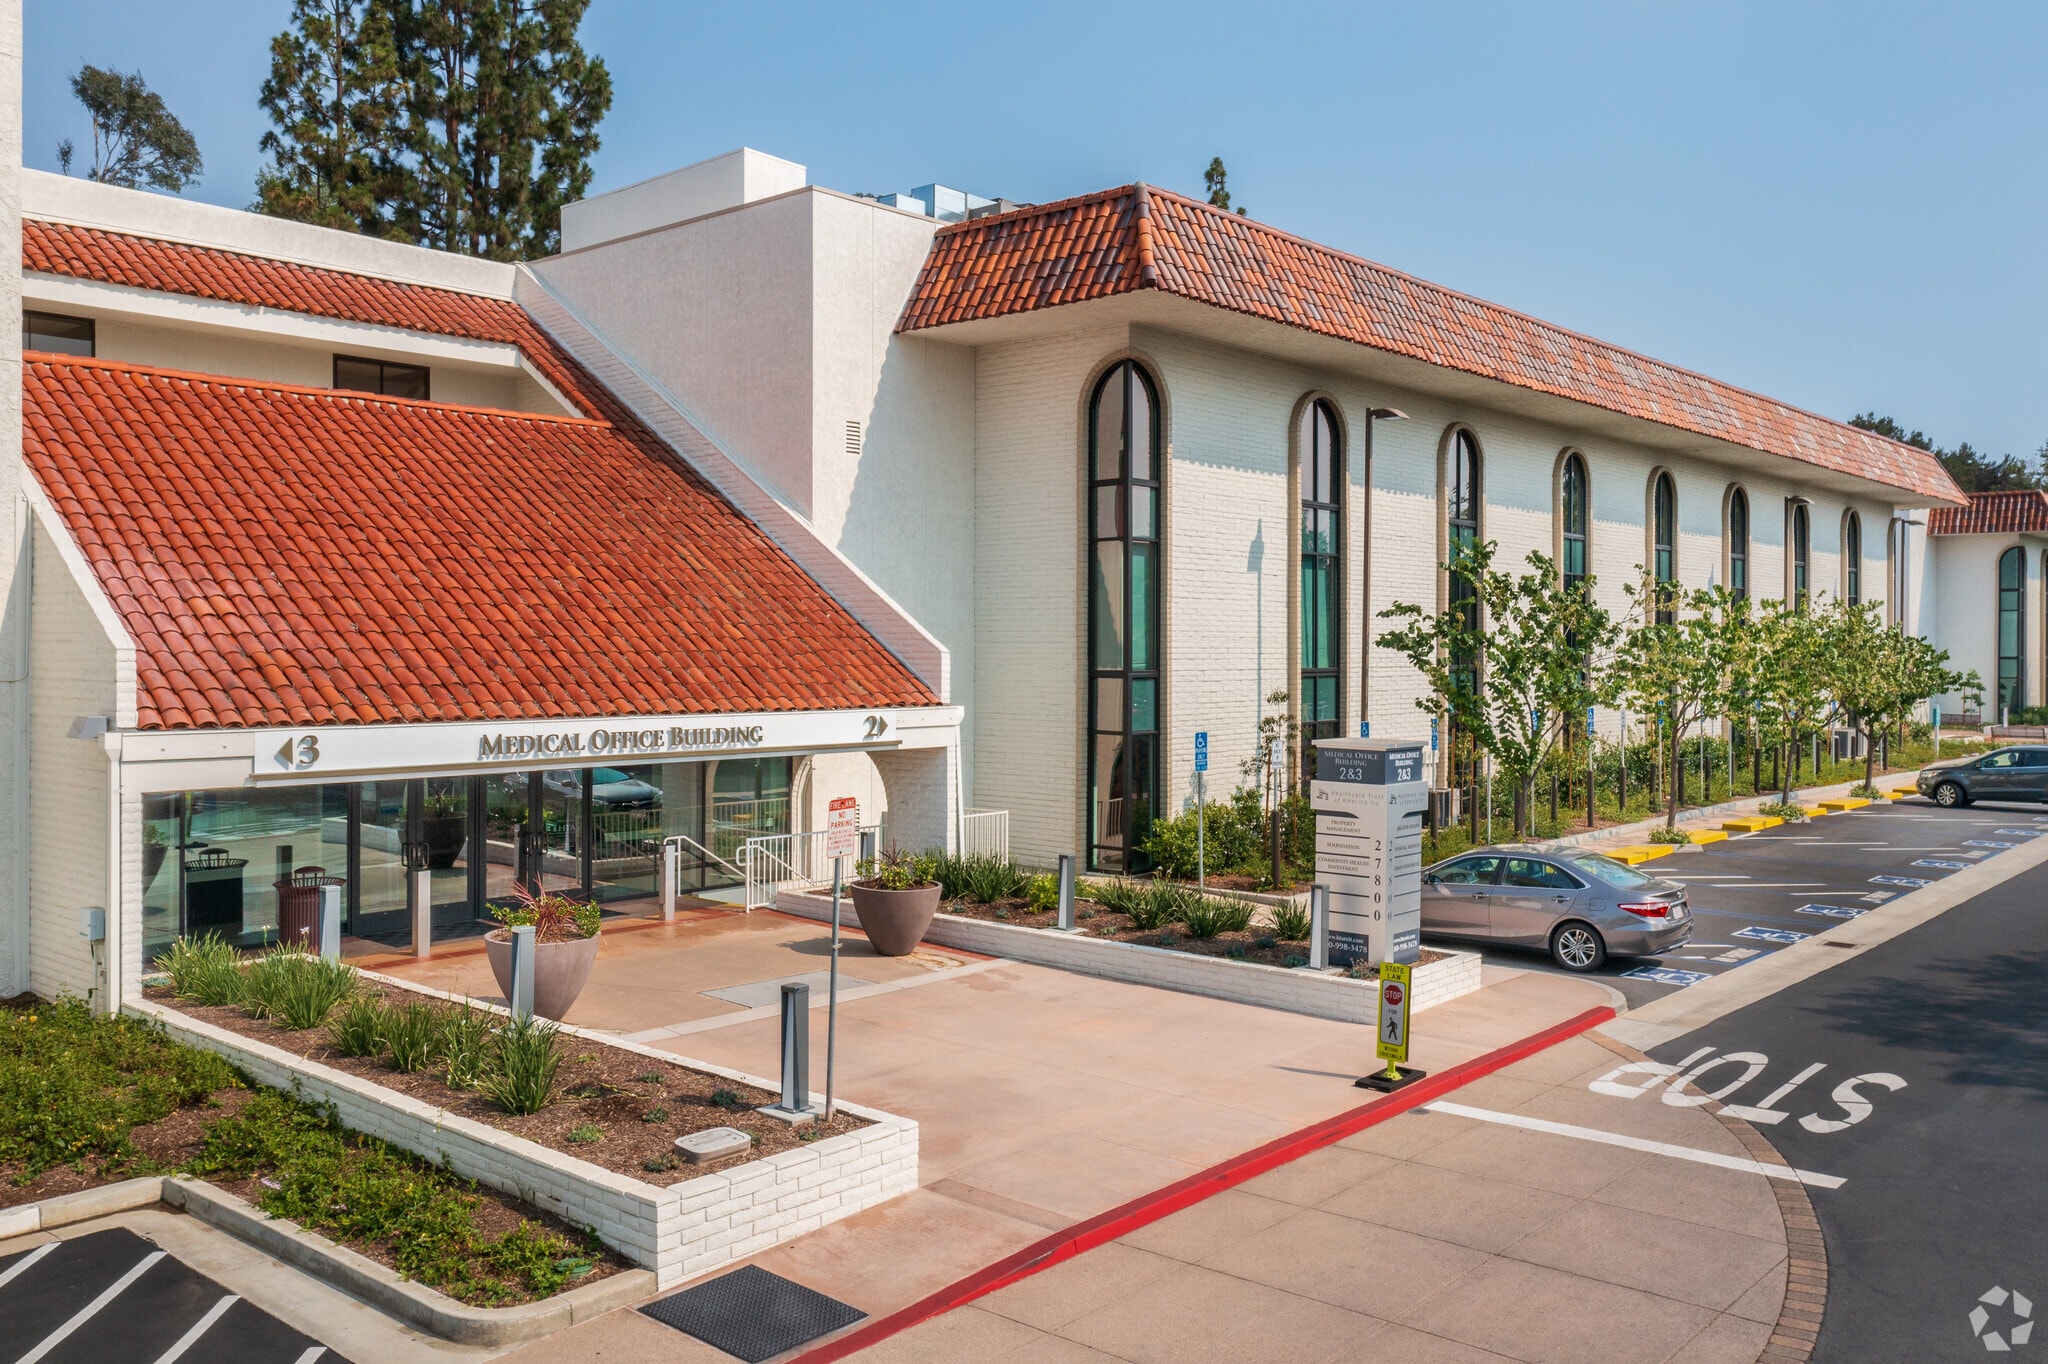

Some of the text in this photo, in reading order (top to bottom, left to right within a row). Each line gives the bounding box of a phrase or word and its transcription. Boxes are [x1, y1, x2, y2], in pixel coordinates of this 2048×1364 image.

[863, 715, 879, 737] 2
[481, 725, 763, 756] MEDICAL OFFICE BUILDING
[299, 734, 320, 765] 3
[1324, 750, 1379, 760] MEDICAL OFFICE
[1389, 751, 1420, 760] MEDICAL OFFICE
[1335, 757, 1368, 766] BUILDING
[1339, 767, 1363, 780] 2&3
[1397, 767, 1411, 781] 2&3
[1331, 790, 1365, 799] Healthcare
[830, 801, 841, 809] FIRE
[838, 811, 846, 819] NO
[831, 819, 853, 829] PARKING
[1331, 819, 1356, 827] PROPERTY
[1326, 826, 1361, 834] MANAGEMENT
[1326, 842, 1360, 850] FOUNDATION
[1317, 856, 1369, 867] COMMUNITY HEALTH
[1327, 864, 1359, 872] INVESTMENT
[1328, 941, 1368, 953] 0-998-3478
[1385, 964, 1405, 975] STATE
[1387, 973, 1402, 981] LAW
[1384, 989, 1402, 1000] STOP
[1388, 1008, 1398, 1016] FOR
[1379, 1050, 1403, 1061] CROSSWALK
[1588, 1046, 1909, 1134] STOP
